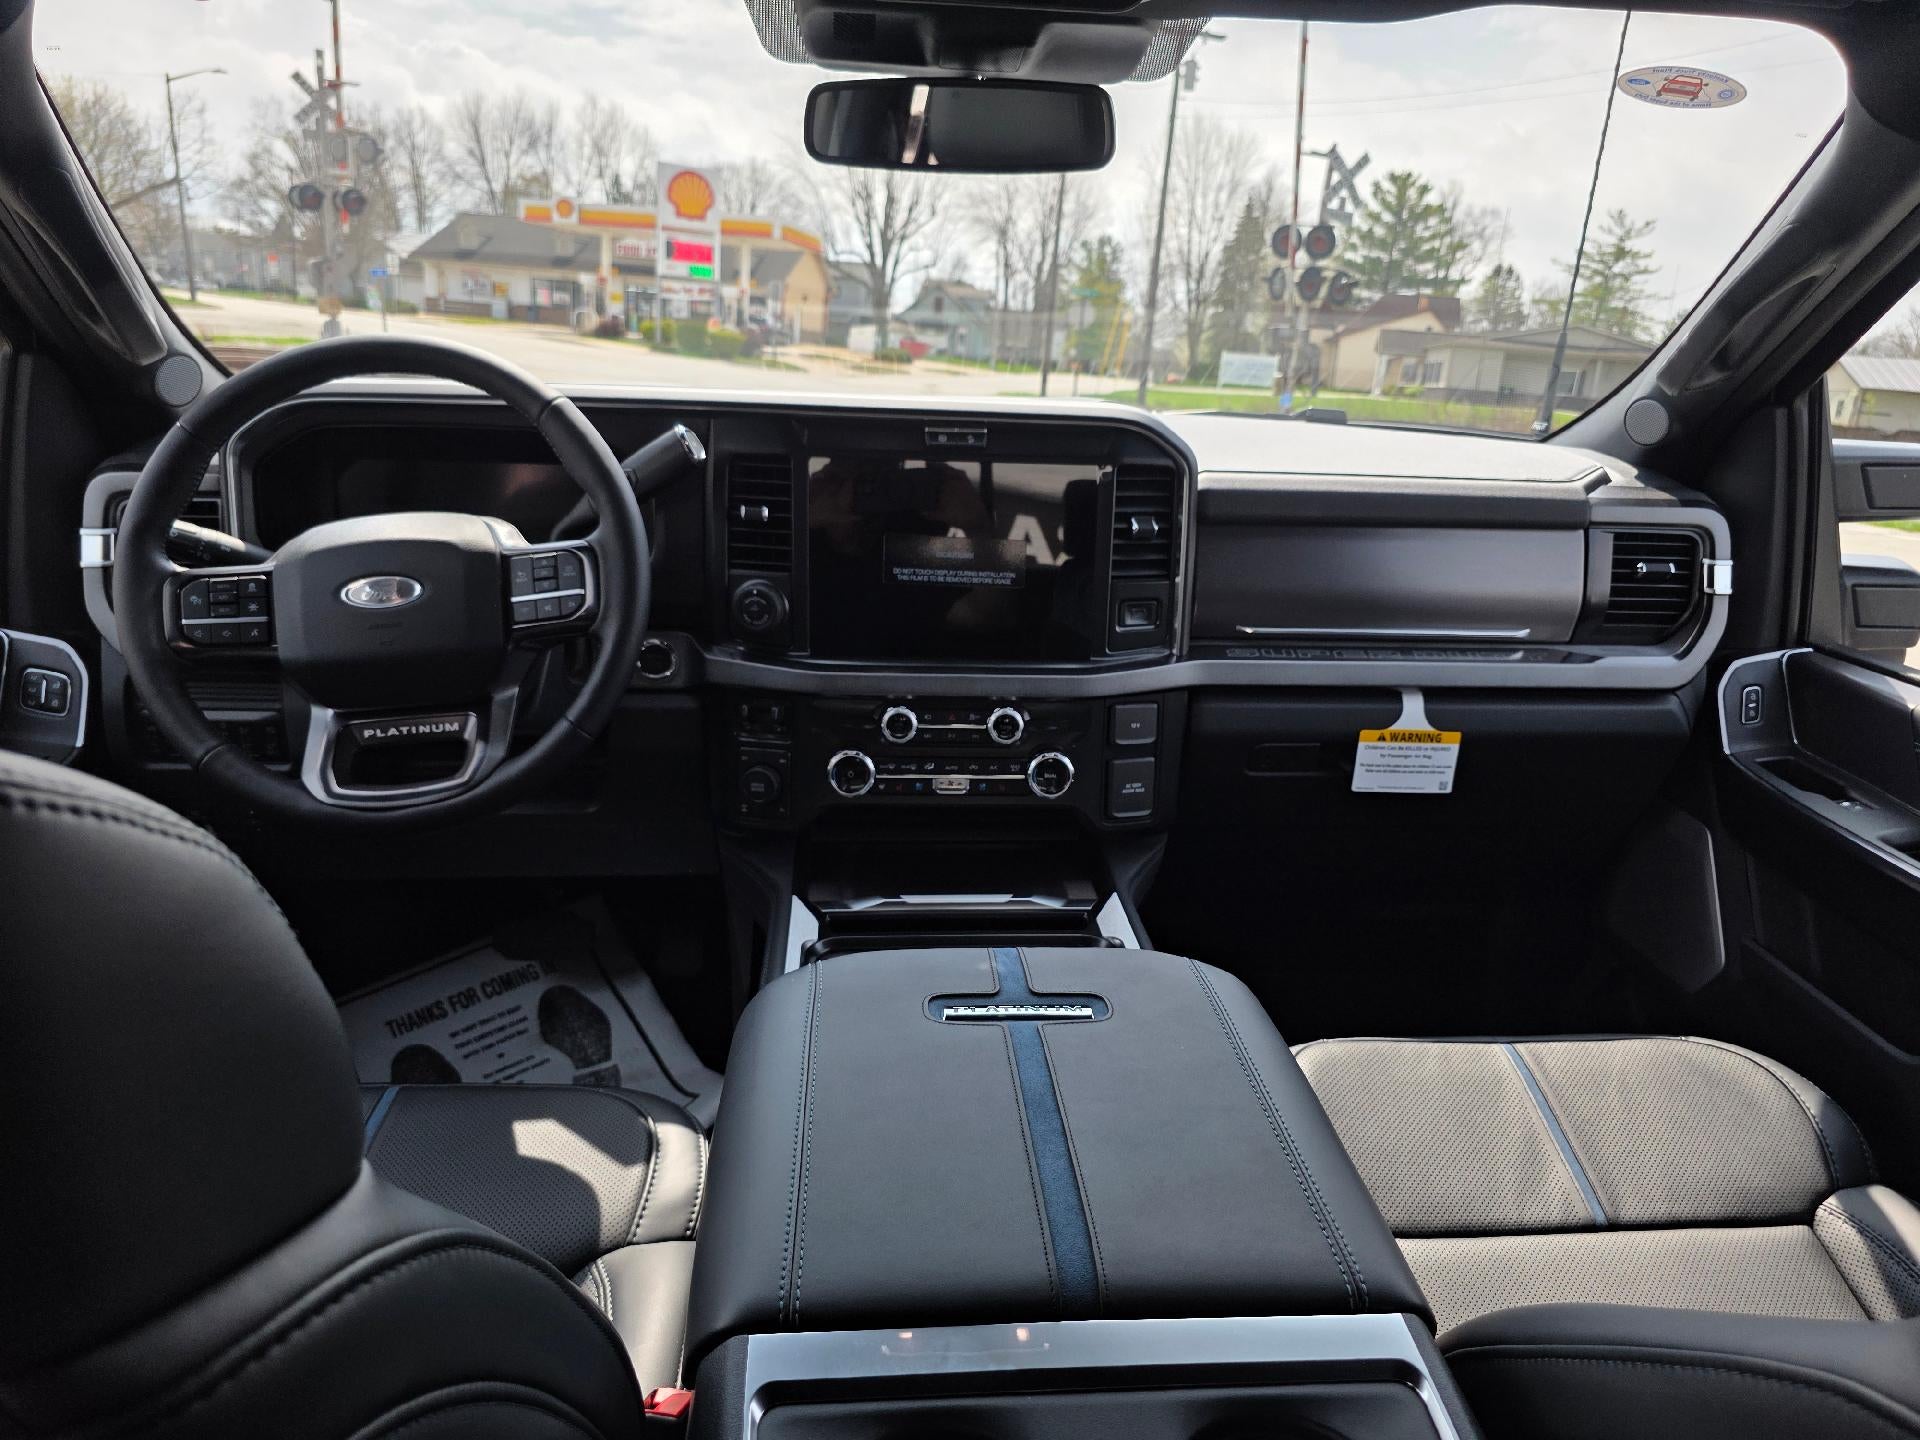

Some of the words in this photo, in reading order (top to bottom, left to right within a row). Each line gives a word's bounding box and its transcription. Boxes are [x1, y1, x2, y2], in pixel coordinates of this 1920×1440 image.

[363, 722, 460, 739] PLATINUM
[1390, 732, 1443, 743] WARNING
[384, 1000, 449, 1039] THANKS
[448, 986, 481, 1013] FOR
[480, 963, 540, 1000] COMING
